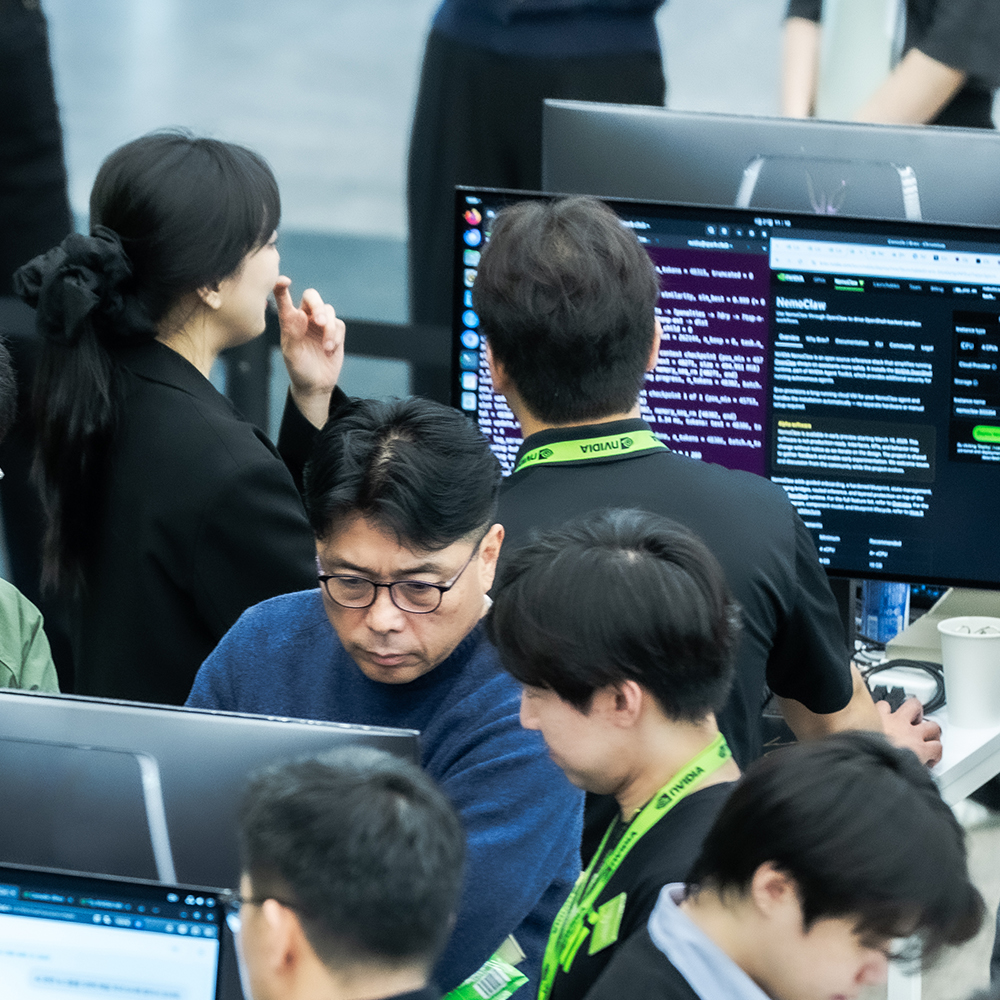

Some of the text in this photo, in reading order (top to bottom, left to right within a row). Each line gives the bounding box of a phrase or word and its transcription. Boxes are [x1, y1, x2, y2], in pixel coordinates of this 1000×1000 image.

[776, 296, 826, 311] NemoClaw
[779, 333, 799, 342] Overview
[835, 338, 869, 346] Documentation
[889, 342, 915, 350] Community
[960, 342, 974, 350] CPU
[579, 440, 620, 454] NVIDIA
[669, 766, 705, 797] NVIDIA
